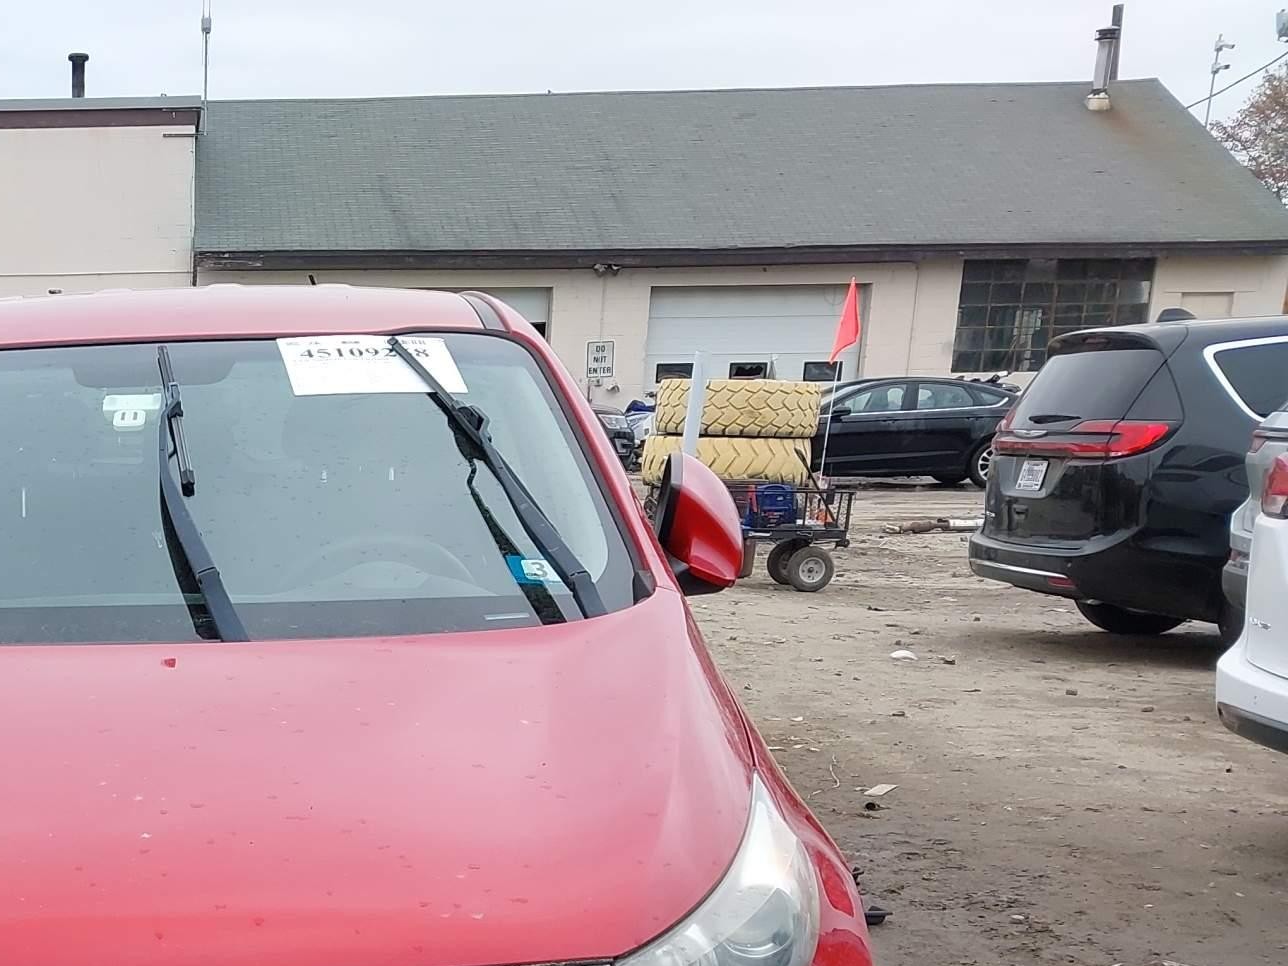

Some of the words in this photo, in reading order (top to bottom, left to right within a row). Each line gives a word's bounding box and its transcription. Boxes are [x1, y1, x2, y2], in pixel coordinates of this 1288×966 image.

[300, 347, 430, 359] 4510928
[596, 345, 606, 353] DO
[588, 367, 611, 375] ENTER
[531, 562, 548, 578] 3
